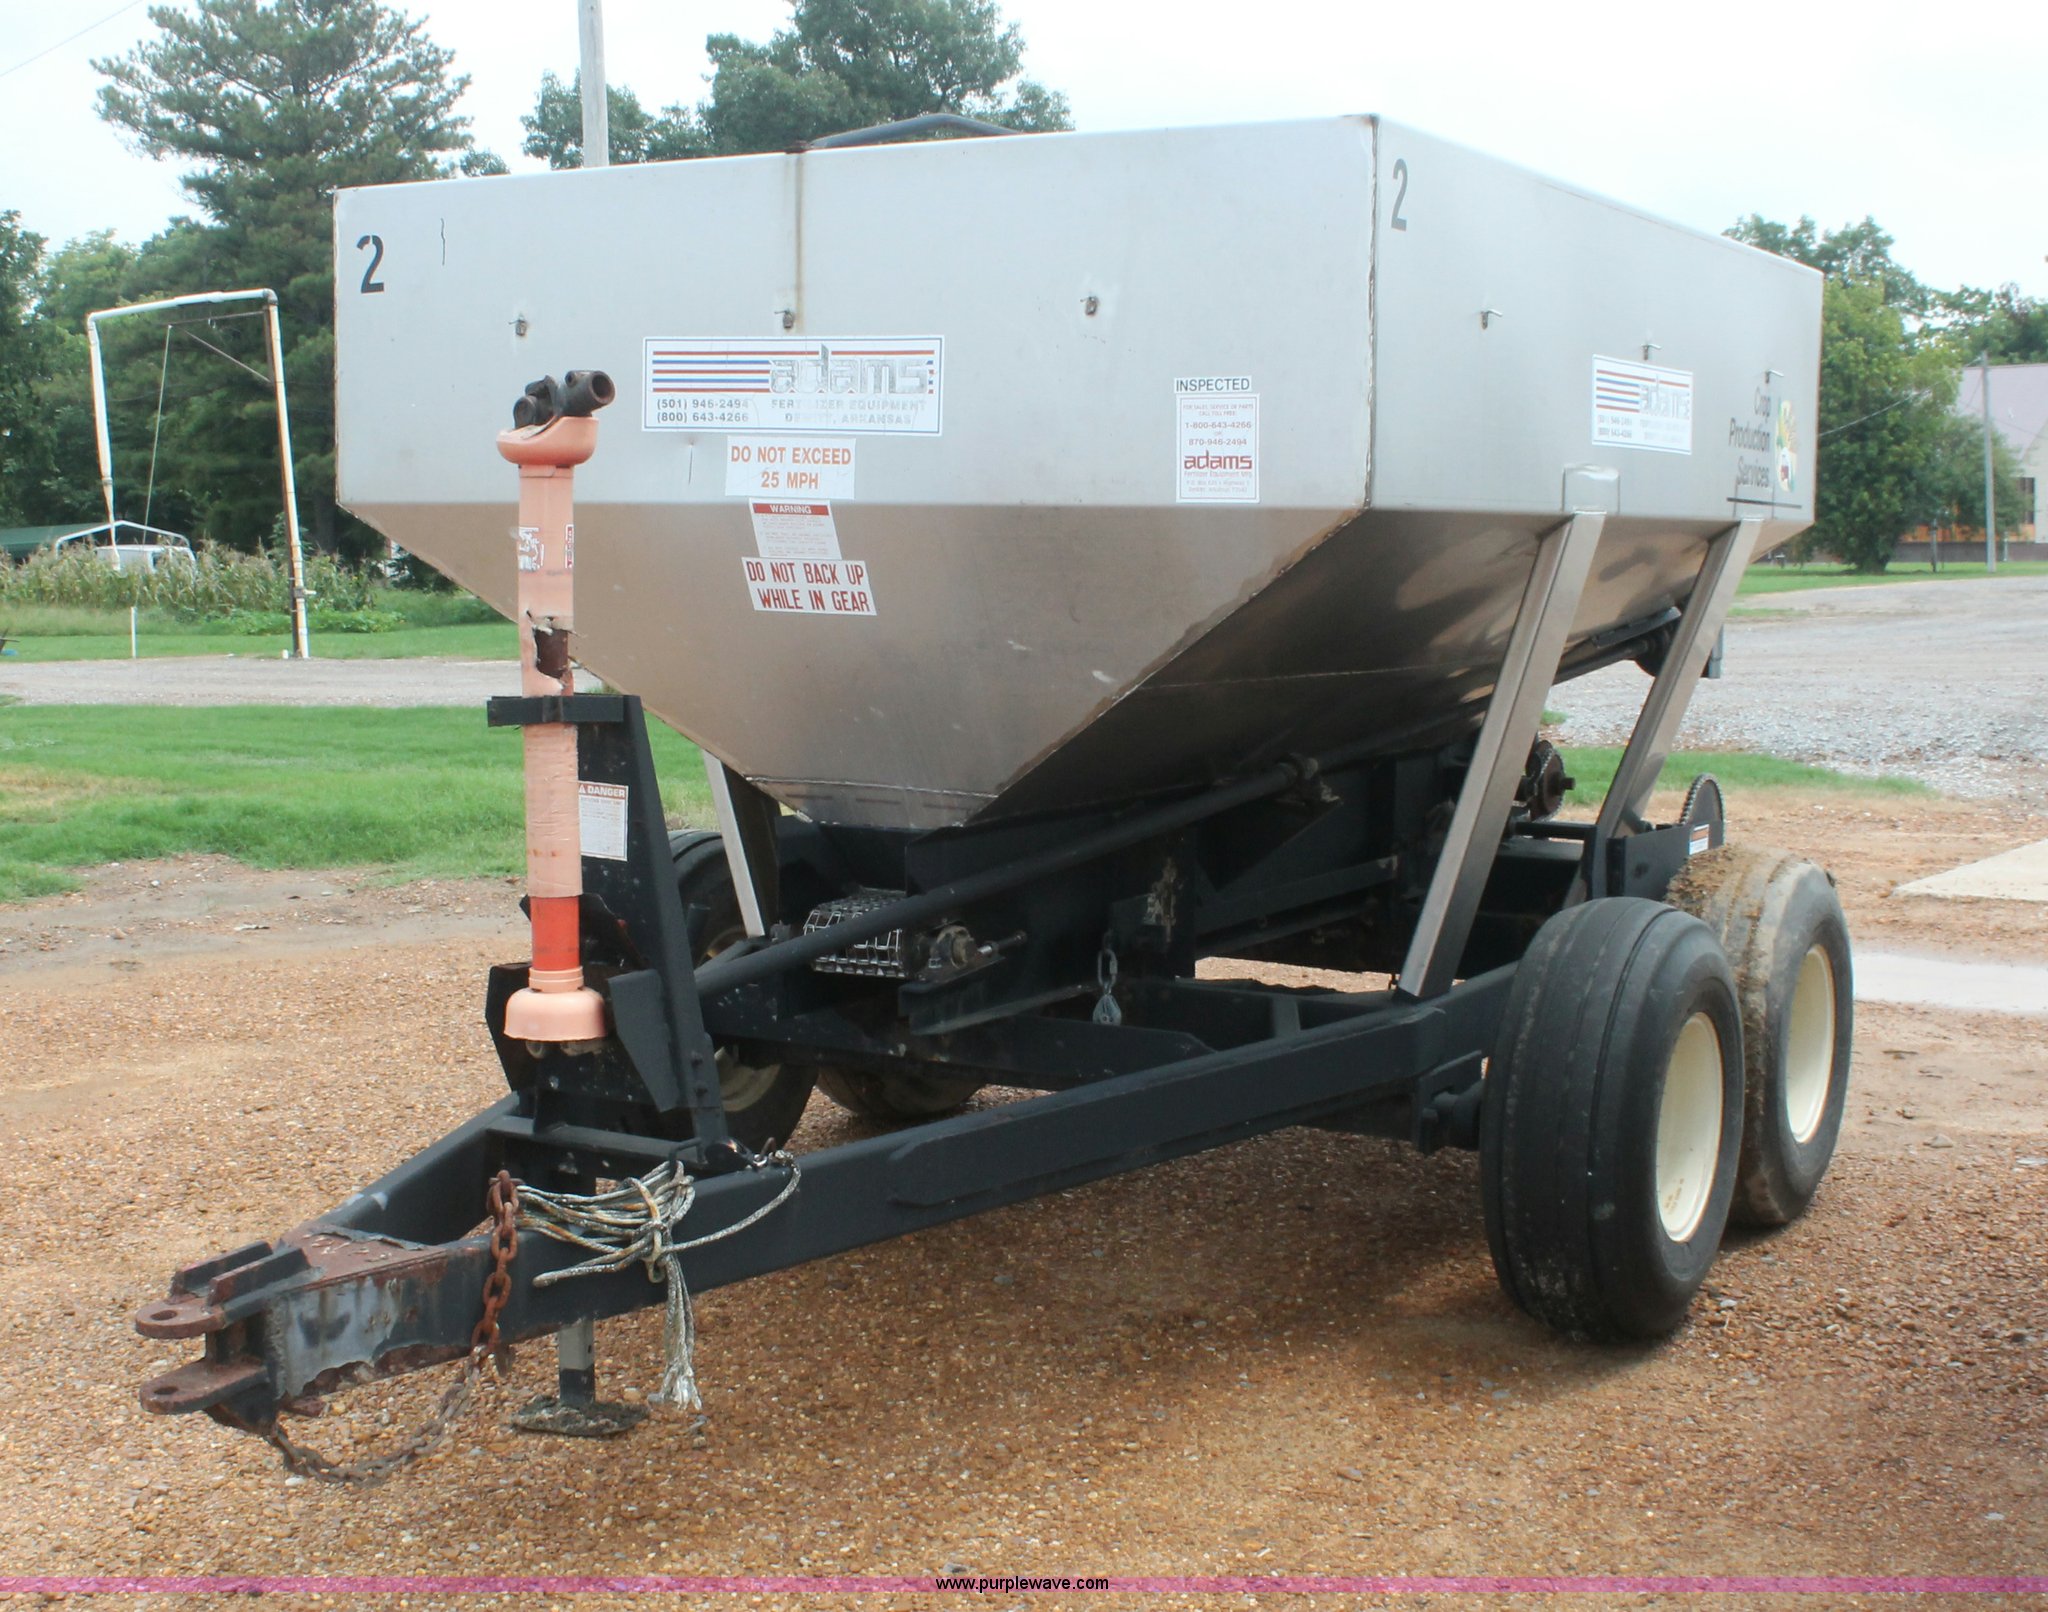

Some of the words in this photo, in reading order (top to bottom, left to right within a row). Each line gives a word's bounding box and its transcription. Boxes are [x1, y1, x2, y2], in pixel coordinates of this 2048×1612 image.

[1391, 158, 1409, 232] 2
[356, 234, 385, 294] 2
[1176, 378, 1250, 392] INSPECTED
[657, 398, 687, 410] (501)
[693, 398, 749, 410] 946-2494
[849, 400, 927, 412] EQUIPMENT
[657, 411, 687, 423] (800)
[693, 412, 749, 422] 643-4266
[1185, 421, 1252, 429] 1-800-643-4266
[1188, 438, 1247, 446] 870-946-2494
[731, 445, 752, 462] DO
[757, 446, 786, 464] NOT
[792, 447, 852, 465] EXCEED
[1184, 450, 1252, 469] adams
[761, 471, 780, 488] 25
[787, 472, 819, 489] MPH
[770, 504, 812, 514] WARNING
[746, 561, 766, 582] DO
[770, 562, 796, 583] NOT
[803, 563, 840, 585] BACK
[845, 564, 865, 586] UP
[756, 588, 804, 609] WHILE
[808, 590, 826, 610] IN
[830, 591, 871, 612] GEAR
[587, 786, 625, 798] DANGER
